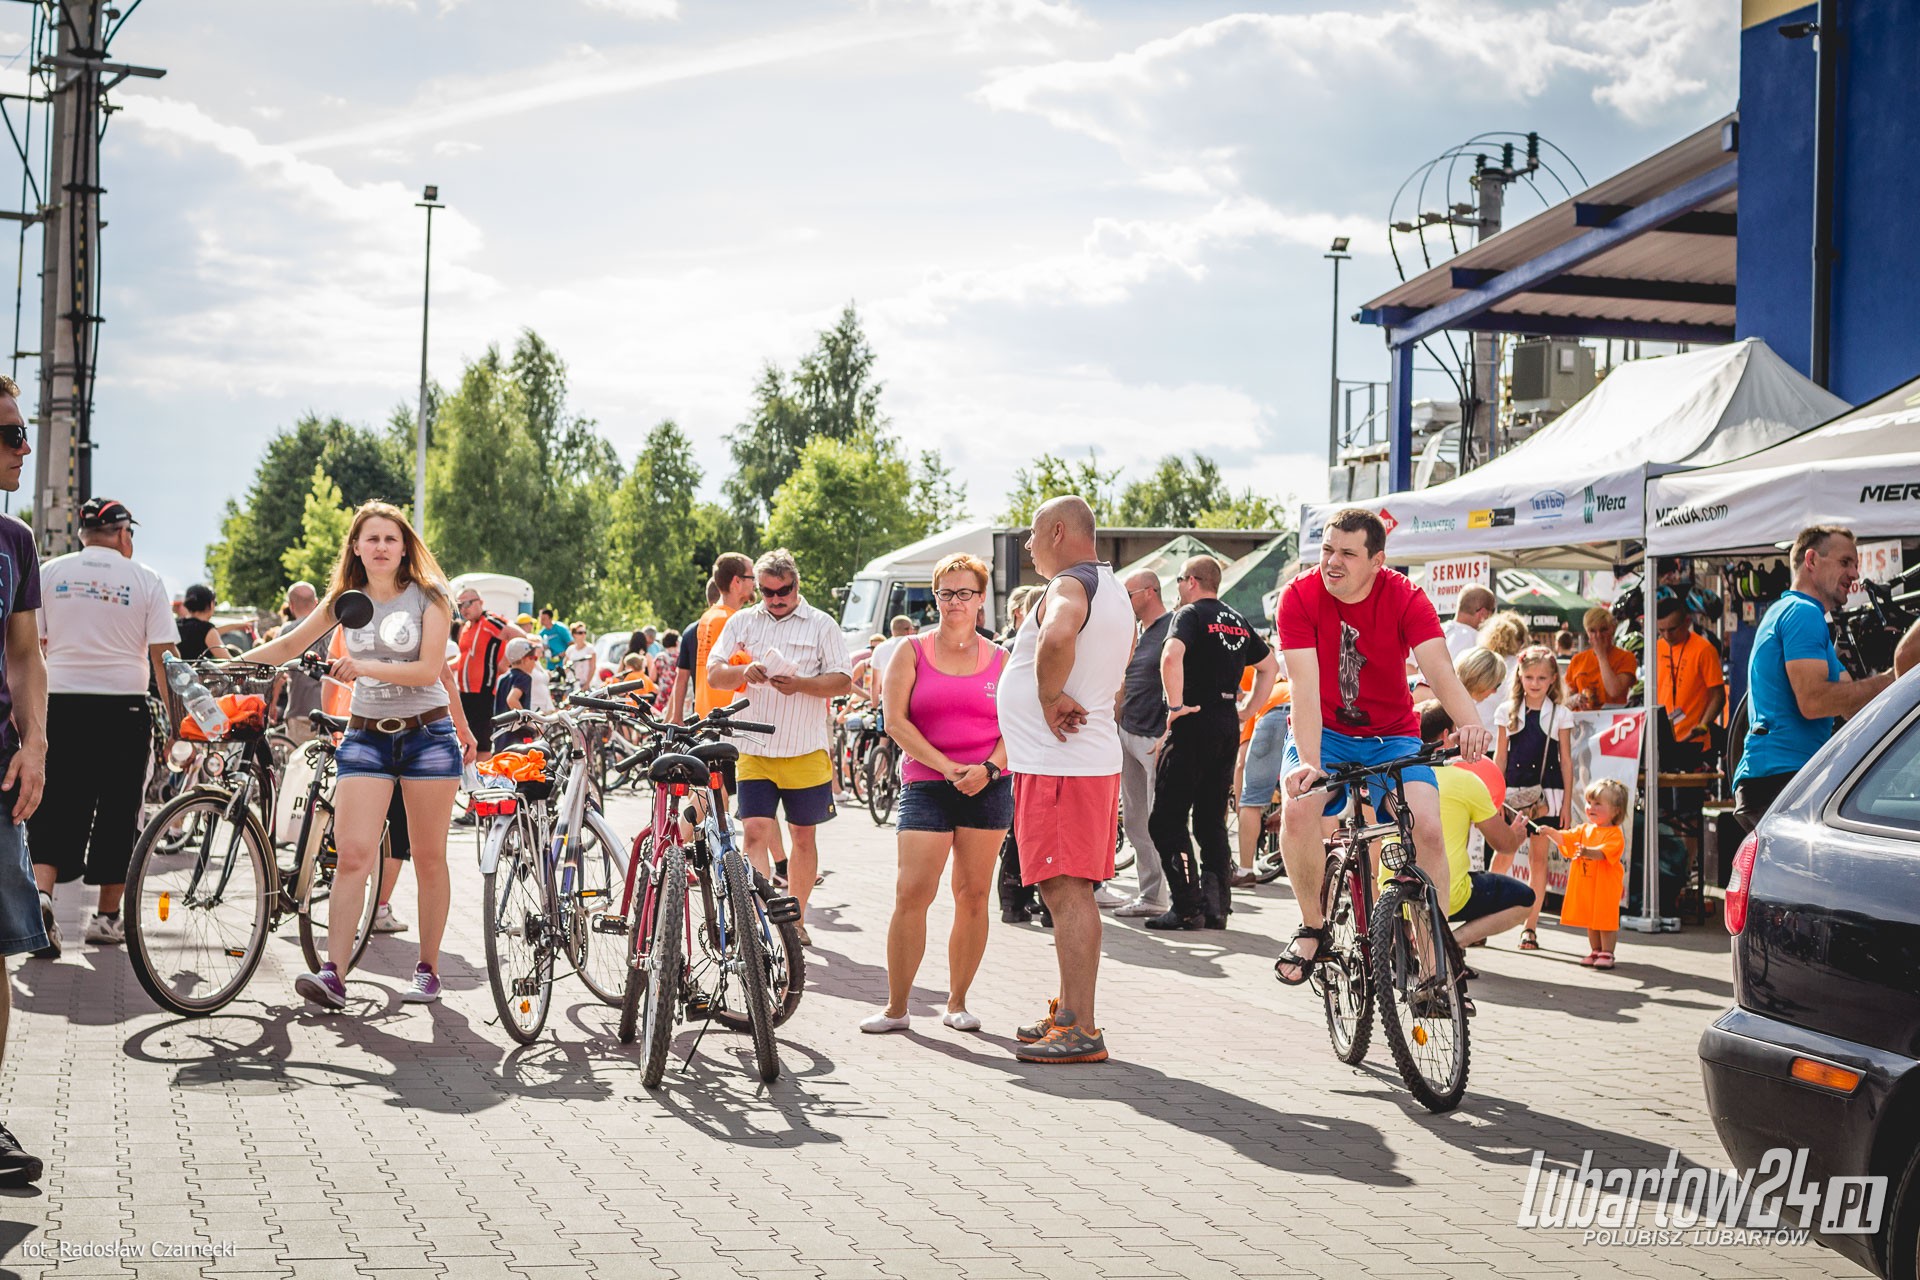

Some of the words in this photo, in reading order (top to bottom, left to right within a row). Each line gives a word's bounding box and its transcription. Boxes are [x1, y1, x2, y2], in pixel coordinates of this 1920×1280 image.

[1530, 493, 1566, 511] Testboy
[1597, 494, 1627, 512] Wera
[1655, 504, 1729, 528] MERIDA.com
[1432, 561, 1480, 582] SERWIS
[1208, 623, 1250, 638] HONDA
